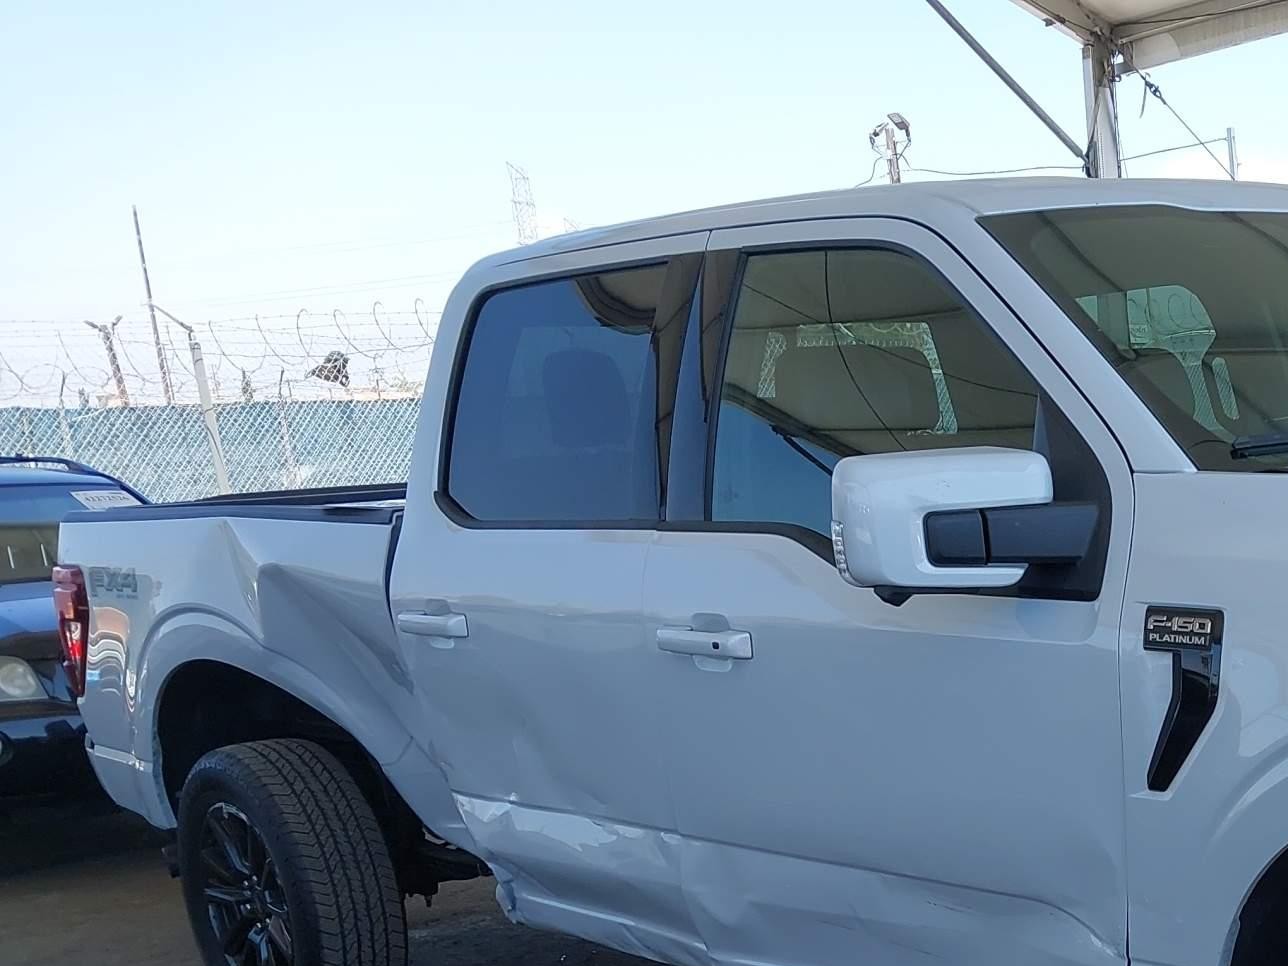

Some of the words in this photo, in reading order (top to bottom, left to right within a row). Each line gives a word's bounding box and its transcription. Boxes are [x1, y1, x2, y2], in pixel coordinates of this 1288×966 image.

[90, 567, 137, 597] FX4
[1147, 615, 1212, 633] F-150
[1149, 633, 1205, 645] PLATINUM
